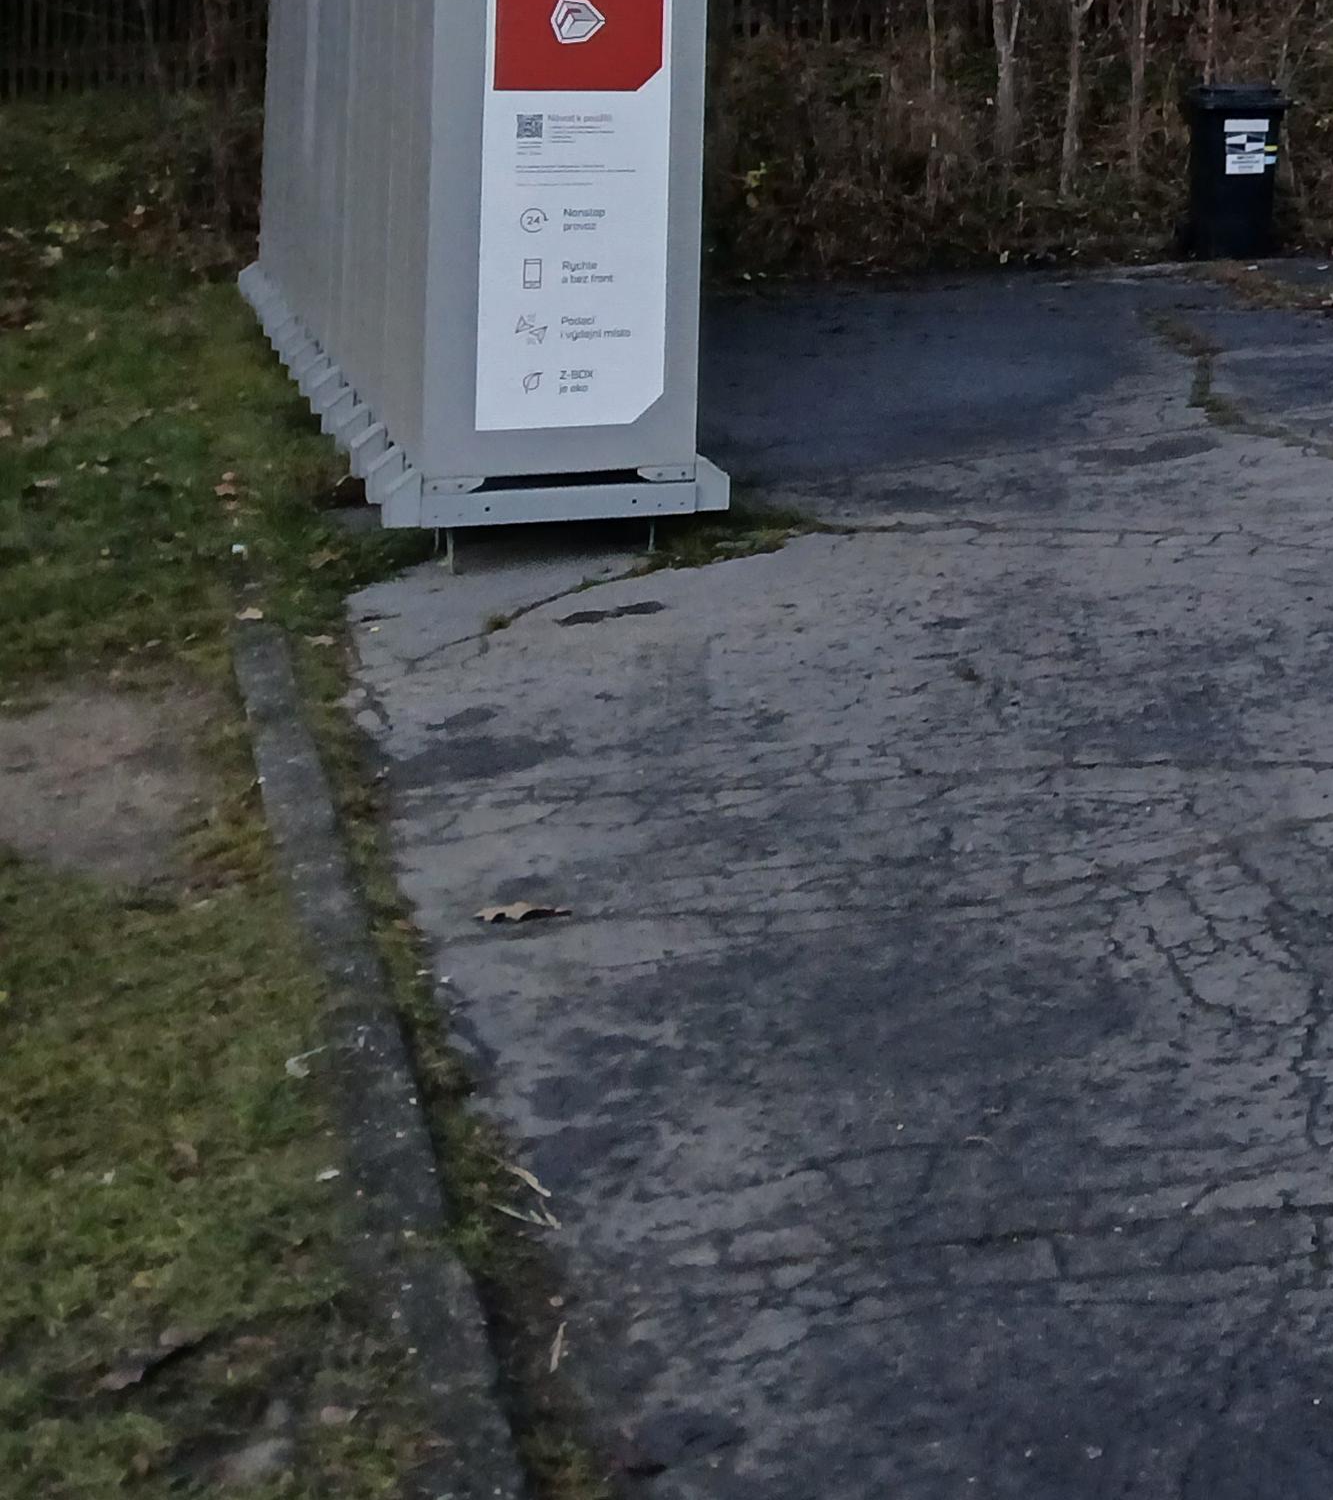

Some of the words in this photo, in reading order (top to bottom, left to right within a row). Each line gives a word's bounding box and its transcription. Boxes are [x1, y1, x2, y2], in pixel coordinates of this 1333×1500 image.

[563, 208, 606, 219] Nonstop
[526, 216, 541, 226] 24
[563, 223, 597, 232] provoz
[562, 261, 598, 273] Rychle
[570, 275, 589, 284] bez
[590, 274, 614, 284] front
[559, 370, 593, 380] Z-BOX
[570, 384, 589, 393] eko
